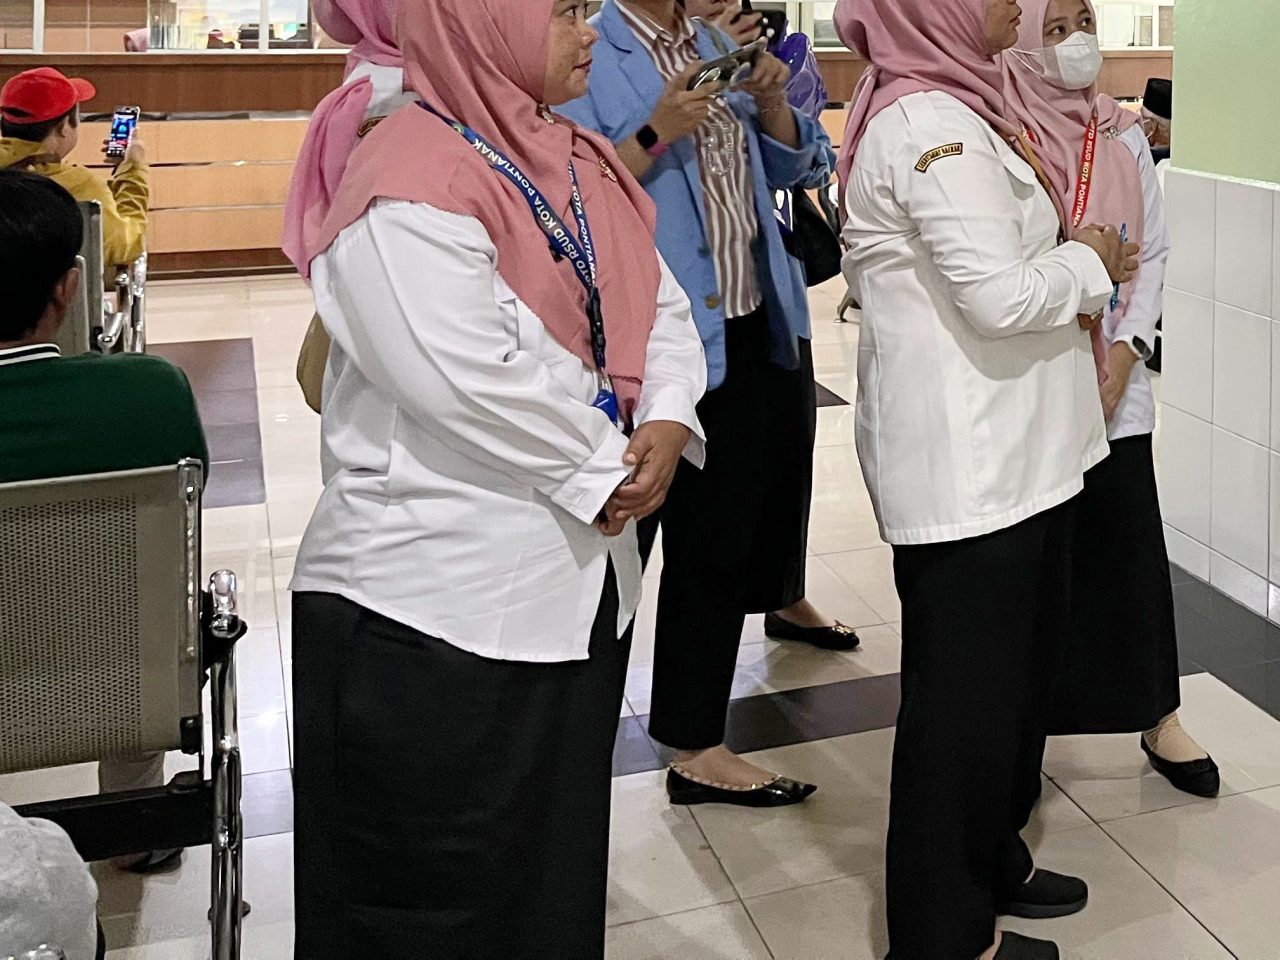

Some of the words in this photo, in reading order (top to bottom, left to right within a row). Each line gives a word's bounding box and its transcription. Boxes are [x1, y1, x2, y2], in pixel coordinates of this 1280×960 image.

[472, 138, 536, 197] PONTIANAK
[1081, 161, 1090, 183] KOTA
[534, 196, 557, 229] KOTA
[553, 228, 580, 260] RSUD
[579, 218, 596, 286] PONTIANA
